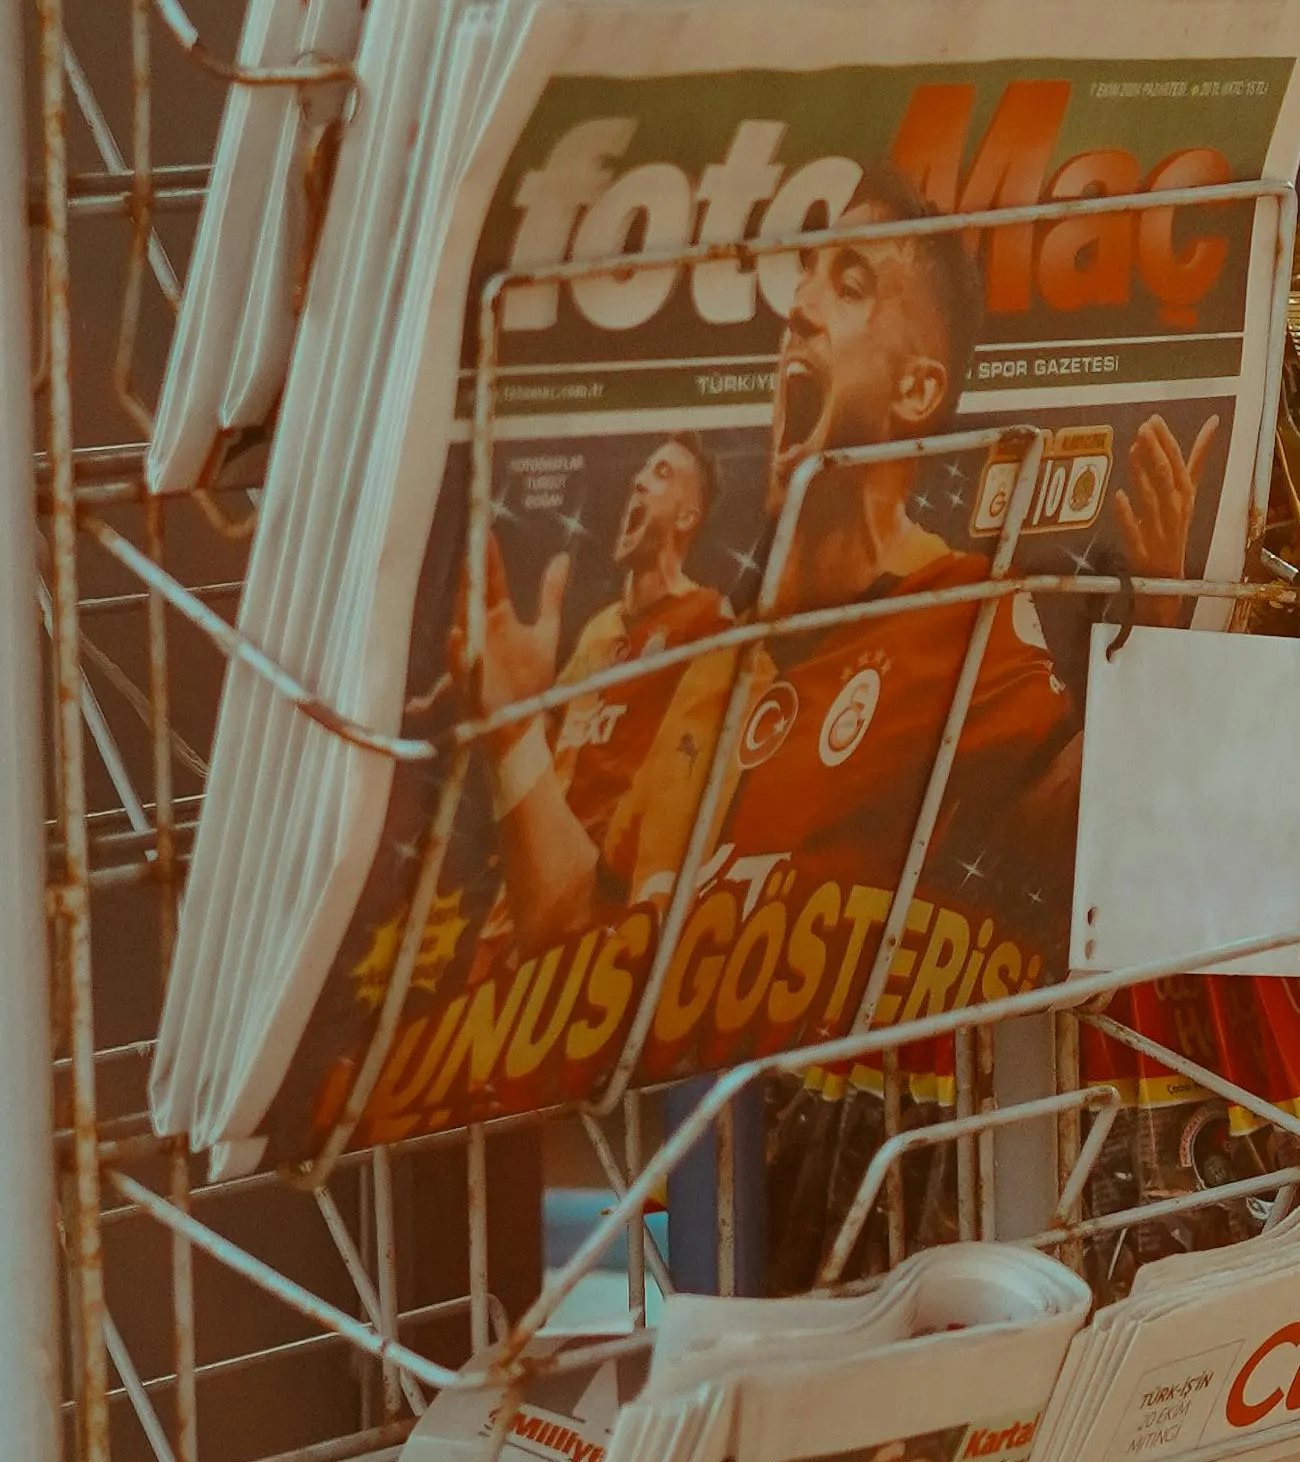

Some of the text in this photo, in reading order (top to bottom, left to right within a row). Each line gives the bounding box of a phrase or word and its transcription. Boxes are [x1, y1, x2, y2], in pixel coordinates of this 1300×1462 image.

[978, 354, 1120, 380] SPOR GAZETESİ
[385, 909, 657, 1112] UNUS
